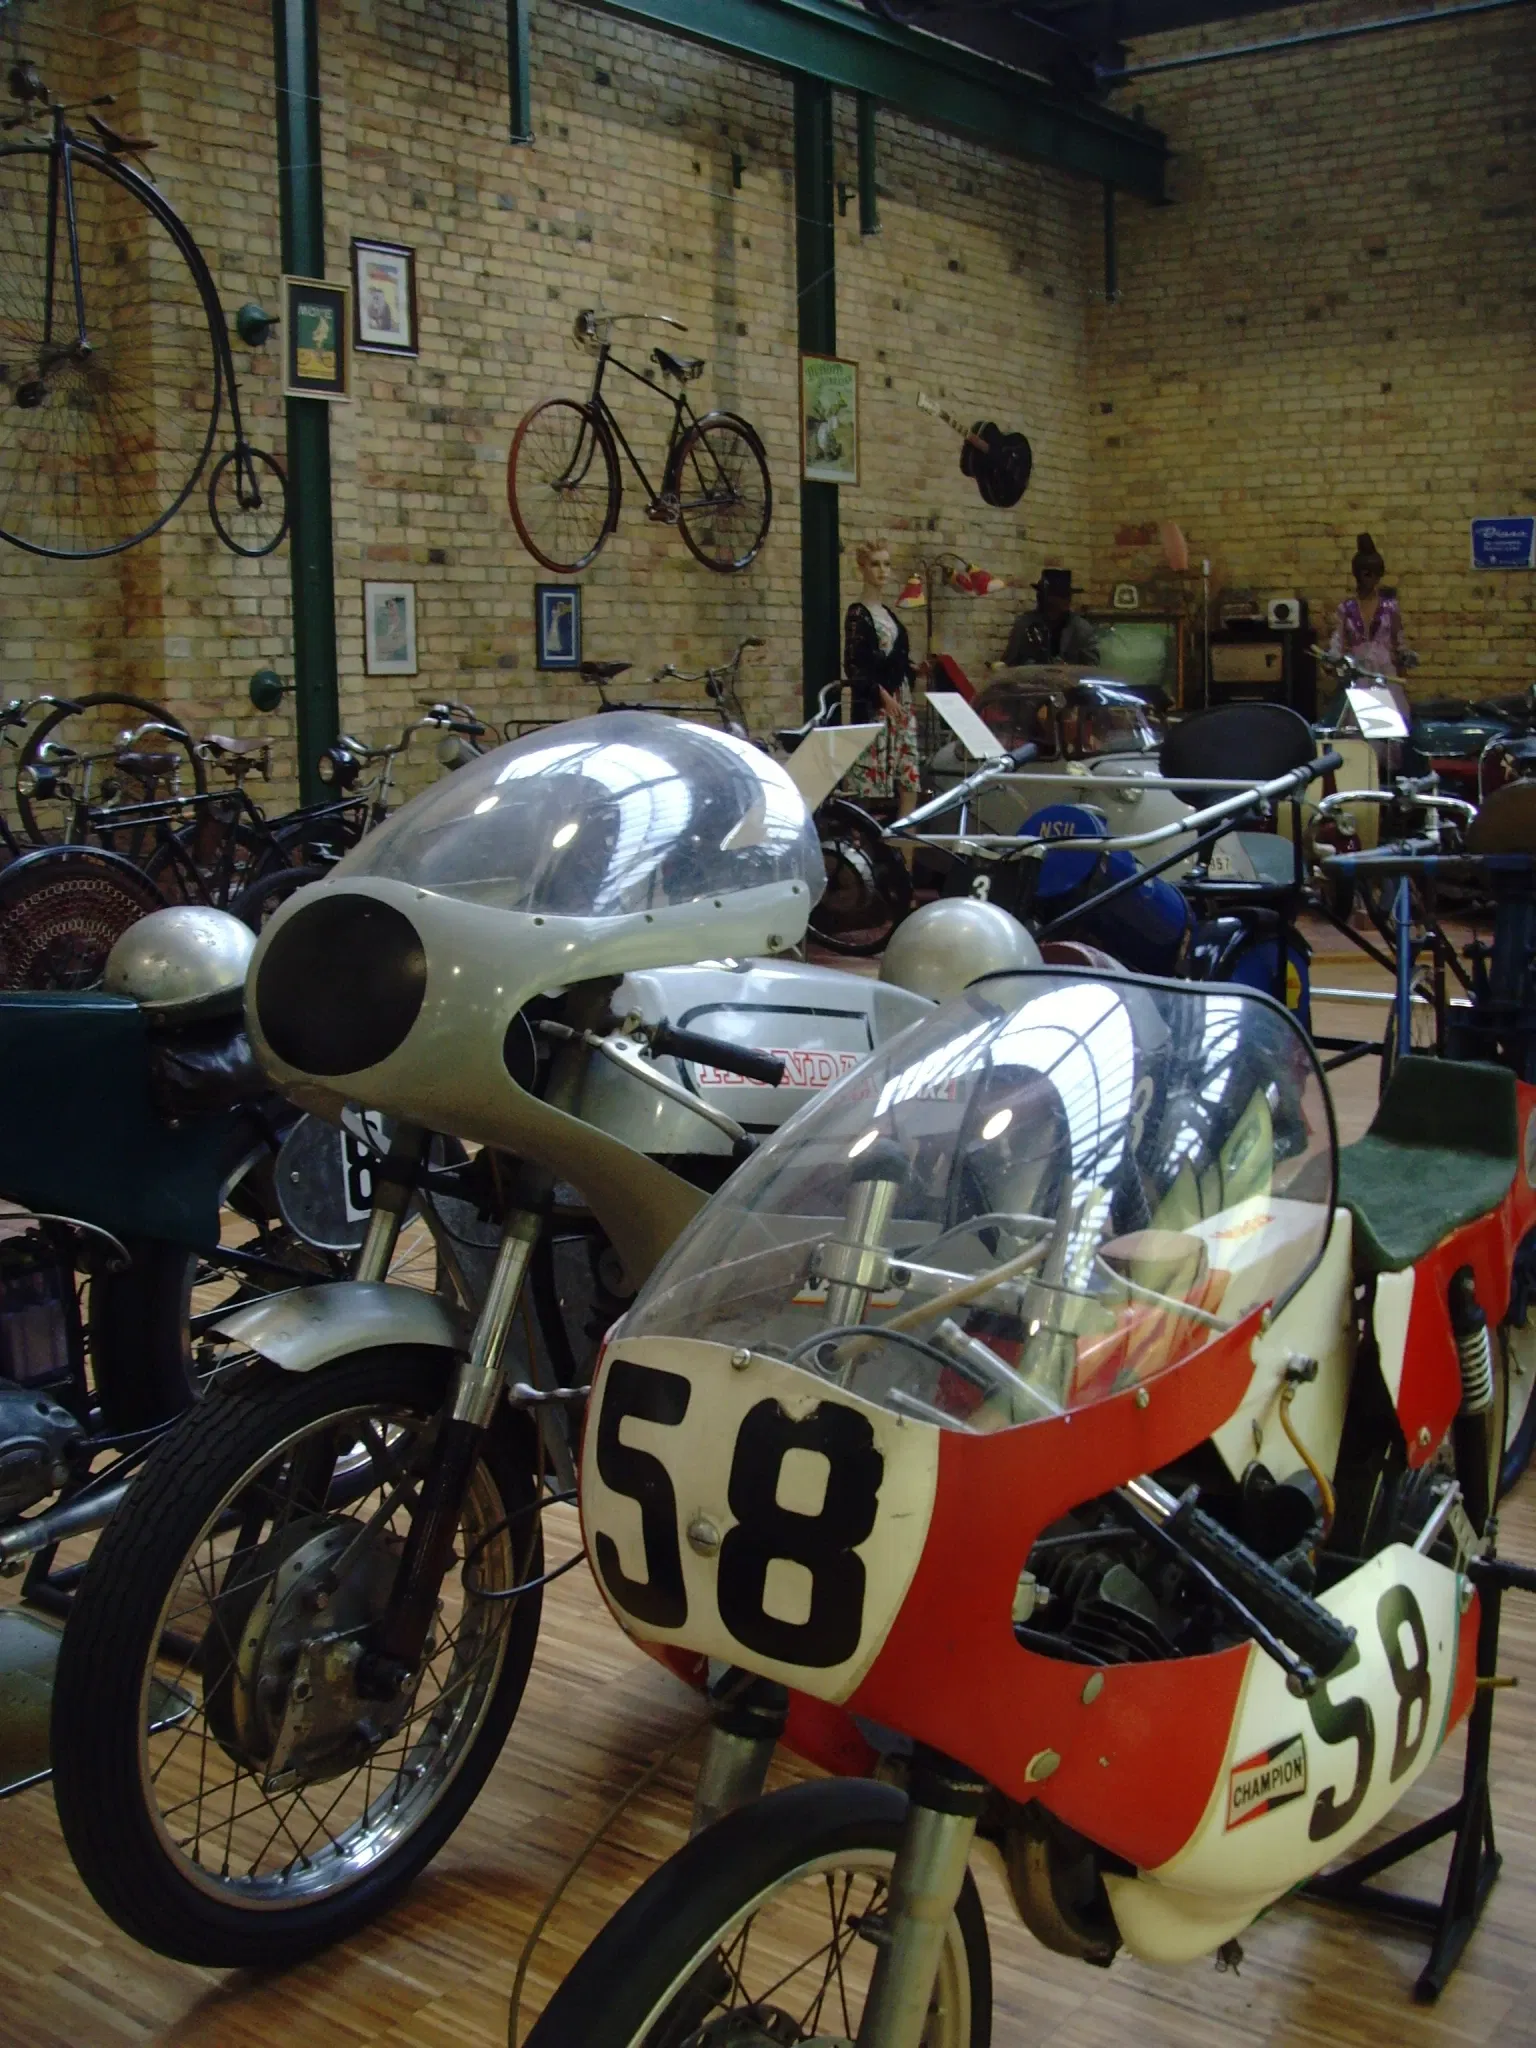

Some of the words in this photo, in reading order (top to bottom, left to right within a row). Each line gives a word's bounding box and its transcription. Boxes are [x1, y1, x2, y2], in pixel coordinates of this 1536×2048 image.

[1040, 822, 1075, 838] NSU
[973, 875, 991, 901] 3
[700, 1047, 868, 1089] NDA
[596, 1359, 884, 1668] 58
[1308, 1584, 1431, 1842] 58
[1233, 1757, 1304, 1808] CHAMPION
